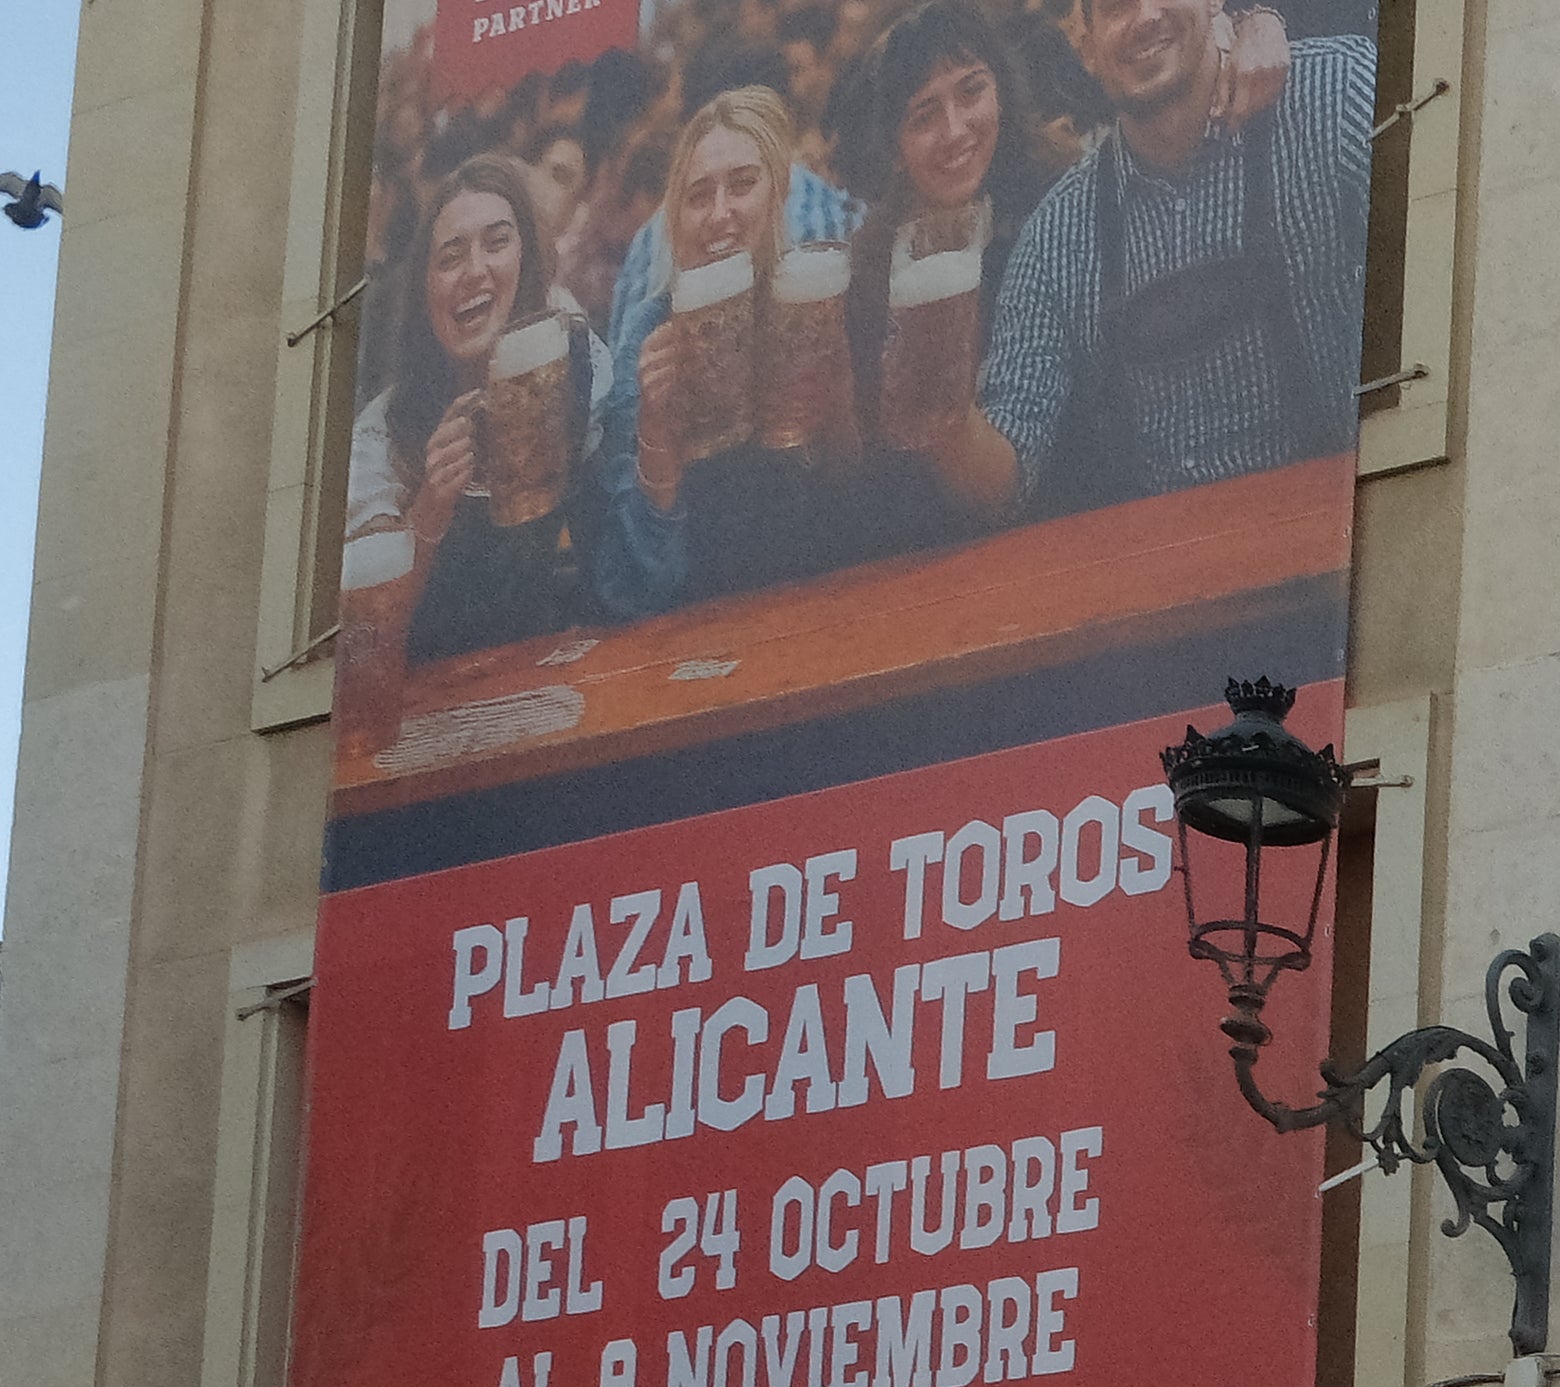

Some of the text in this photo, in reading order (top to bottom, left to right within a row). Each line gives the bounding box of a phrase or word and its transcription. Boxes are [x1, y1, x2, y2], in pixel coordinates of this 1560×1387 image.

[447, 783, 1177, 1030] PLAZA DE TOROS
[532, 936, 1062, 1163] ALICANTE
[478, 1126, 1105, 1331] DEL 24 OCTUBRE
